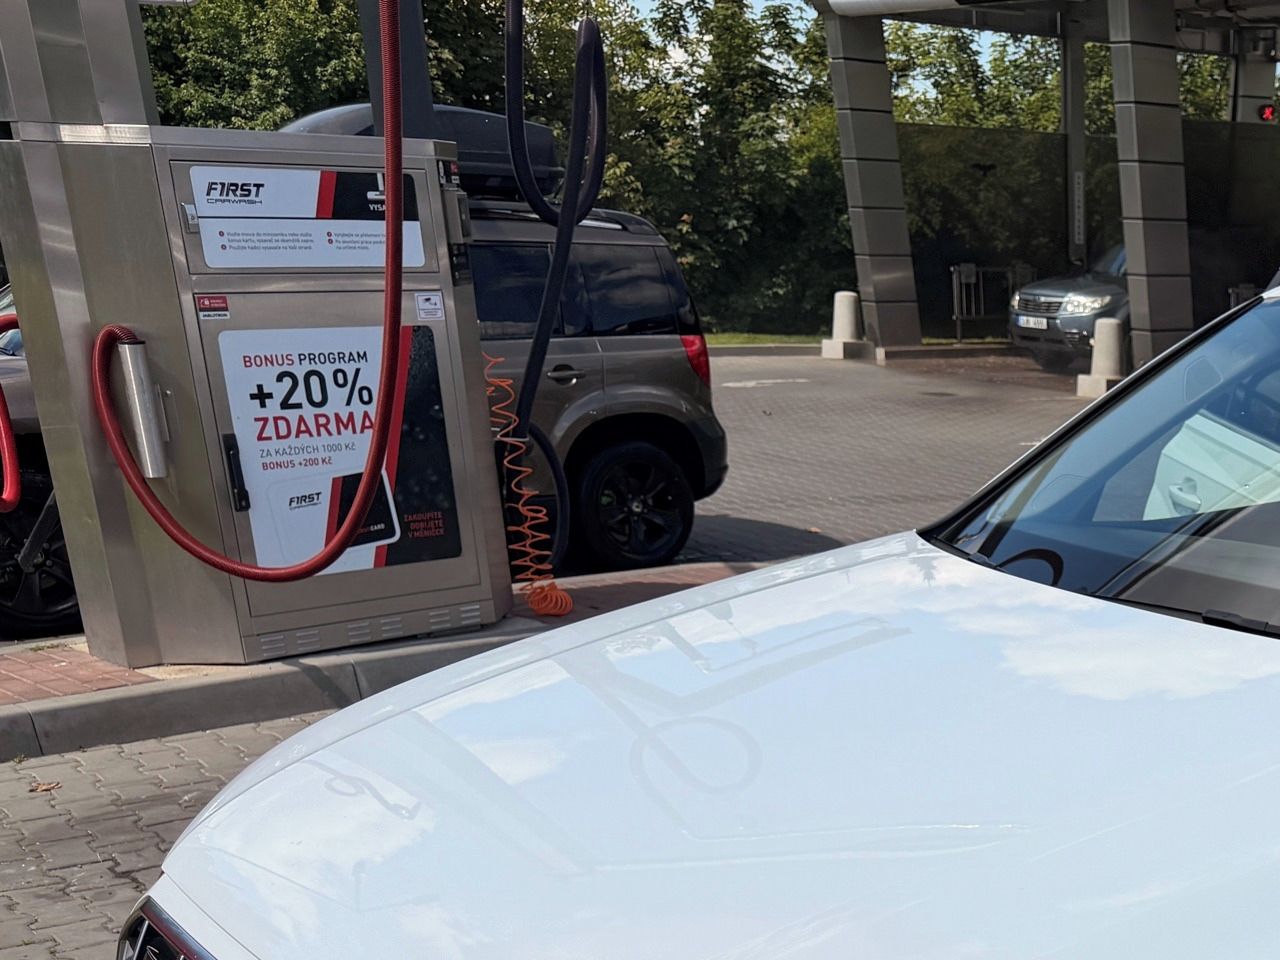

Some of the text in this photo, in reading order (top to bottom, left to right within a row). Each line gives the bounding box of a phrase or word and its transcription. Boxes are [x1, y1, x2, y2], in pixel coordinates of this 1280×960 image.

[242, 351, 368, 368] BONUS PROGRAM
[249, 368, 373, 410] +20%
[254, 410, 375, 441] ZDARMA
[260, 441, 356, 458] ZA KAŽDÝCH 1000 Kč
[262, 456, 333, 471] BONUS +200 Kč
